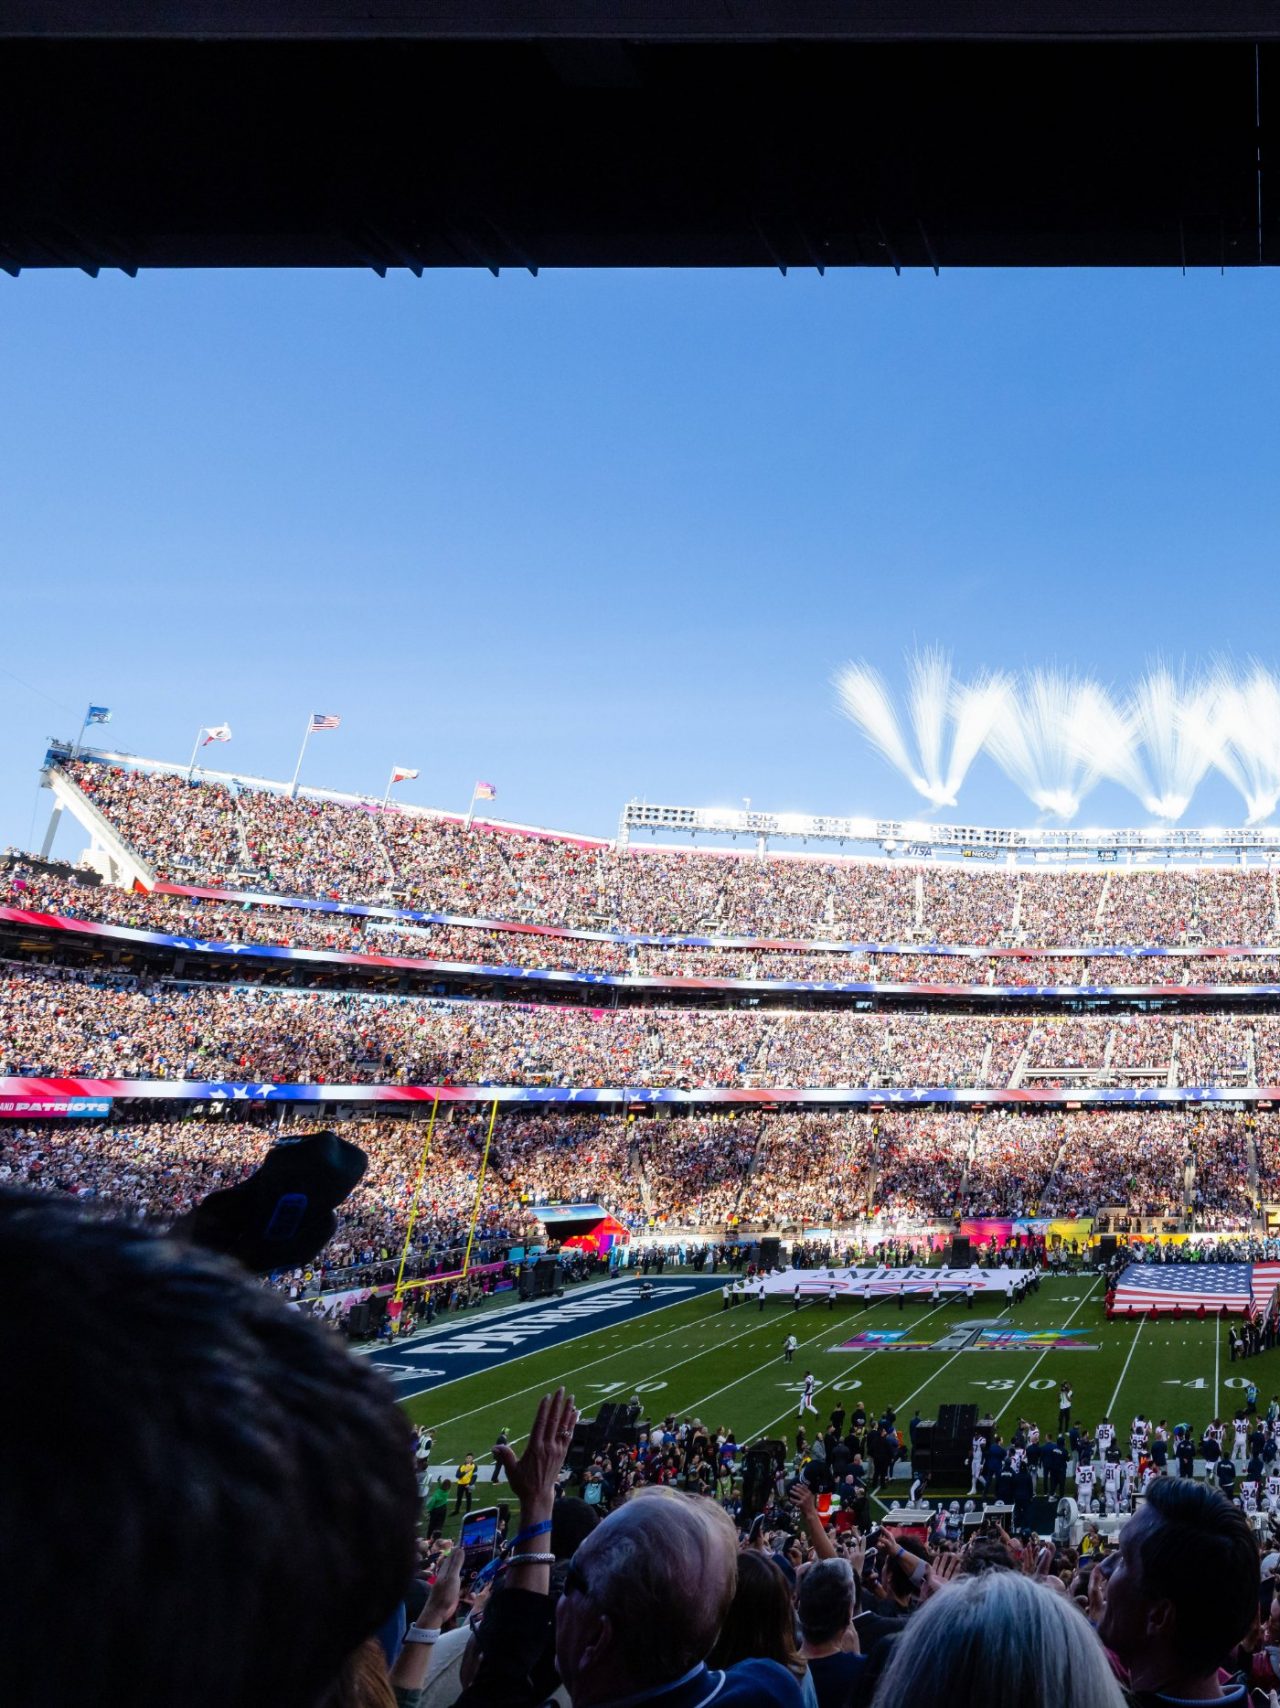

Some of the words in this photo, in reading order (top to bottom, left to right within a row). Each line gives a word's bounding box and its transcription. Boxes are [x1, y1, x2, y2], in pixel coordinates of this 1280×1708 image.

[907, 846, 932, 856] VISA
[972, 851, 998, 860] NetApp
[15, 1103, 110, 1112] PATRIOTS
[810, 1270, 992, 1280] AMERICA
[400, 1286, 696, 1354] PATRIOTS
[593, 1381, 668, 1393] 10
[985, 1379, 1057, 1390] 30
[1183, 1377, 1250, 1389] 40
[1080, 1472, 1092, 1484] 33
[1105, 1469, 1115, 1480] 91
[1269, 1484, 1280, 1495] 31
[1243, 1490, 1256, 1501] 24
